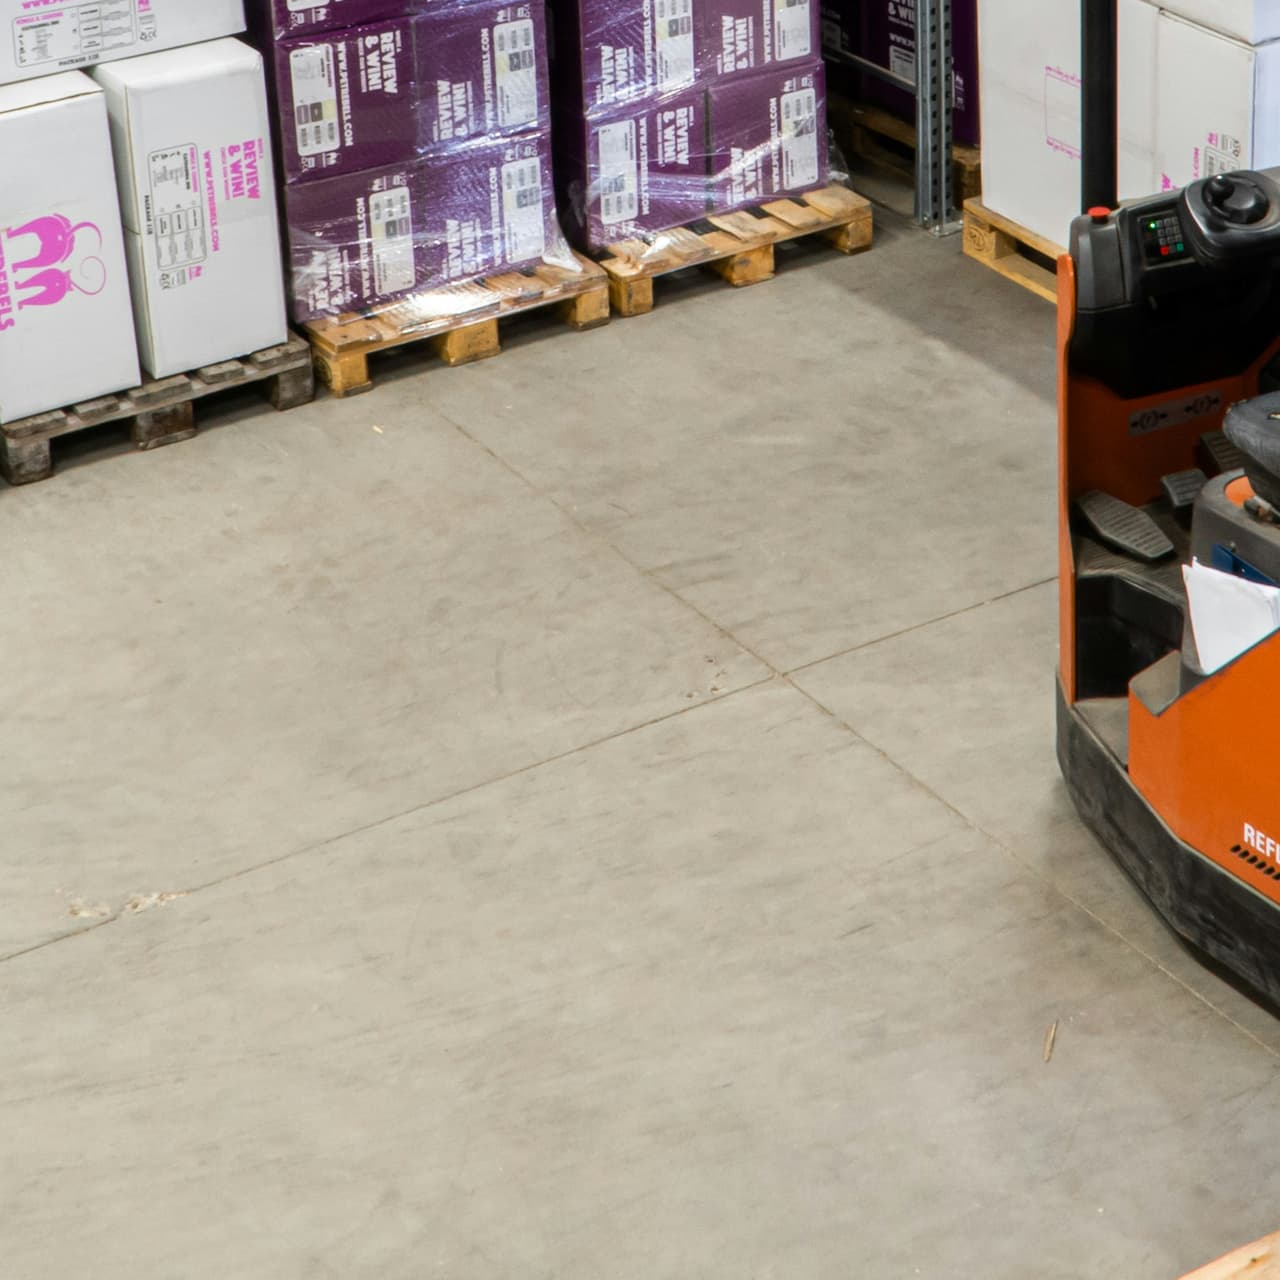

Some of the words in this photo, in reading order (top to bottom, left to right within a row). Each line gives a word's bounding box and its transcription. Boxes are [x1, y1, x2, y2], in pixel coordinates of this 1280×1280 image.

[364, 35, 379, 49] &
[380, 31, 398, 94] REVIEW
[228, 145, 241, 156] &
[243, 140, 261, 199] REVIEW
[230, 159, 245, 198] WIN!
